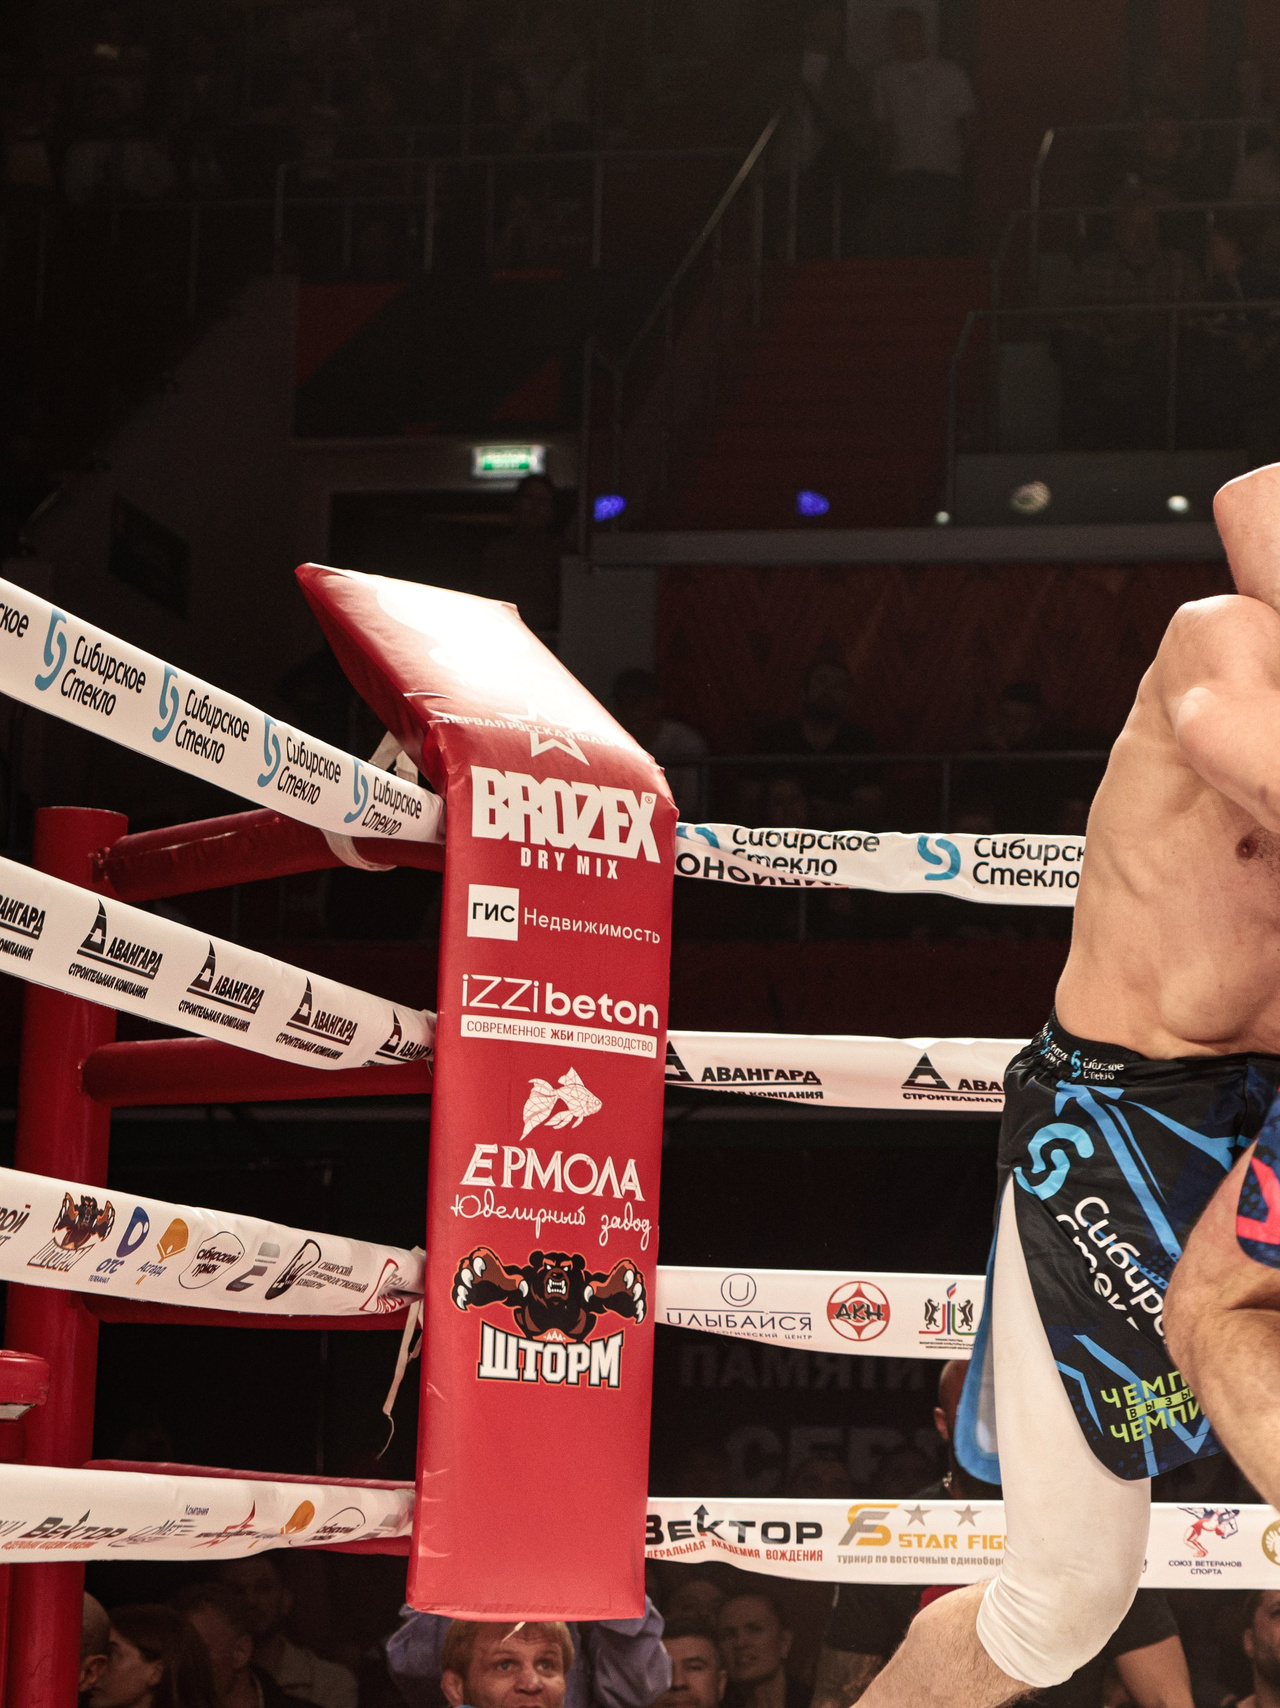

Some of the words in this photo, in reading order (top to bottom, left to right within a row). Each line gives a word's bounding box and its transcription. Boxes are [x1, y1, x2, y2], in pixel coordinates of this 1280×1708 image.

[73, 635, 147, 694] Сибирское
[60, 668, 117, 716] Стекло
[184, 688, 249, 742] Сибирское
[175, 720, 226, 764] Стекло
[286, 737, 342, 784] Сибирское
[277, 765, 321, 805] Стекло
[373, 775, 423, 819] Сибирское
[361, 804, 402, 836] Стекло
[471, 765, 661, 863] BROZEX
[732, 828, 880, 853] Сибирское
[520, 847, 565, 872] DRY
[577, 855, 618, 879] MIX
[972, 861, 1080, 888] Стекло
[472, 902, 516, 923] ГИС
[524, 907, 661, 944] Недвижимость
[106, 936, 163, 980] АВАНГАРД
[68, 963, 115, 990] СТРОИТЕЛЬНАЯ
[115, 976, 148, 999] КОМПАНИЯ
[212, 975, 265, 1014] АВАНГАРД
[178, 1000, 219, 1024] СТРОИТЕЛЬНАЯ
[219, 1011, 250, 1032] КОМПАНИЯ
[312, 1010, 358, 1045] АВАНГАРД
[276, 1032, 313, 1053] СТРОИТЕЛЬНАЯ
[312, 1040, 343, 1060] КОМПАНИЯ
[466, 1020, 547, 1039] СОВРЕМЕННОЕ
[550, 1028, 574, 1042] ЖБИ
[577, 1031, 654, 1053] ПРОИЗВОДСТВО
[701, 1067, 822, 1085] АВАНГАРД
[460, 1143, 646, 1202] ЕРМОЛА
[450, 1188, 587, 1239] Ювелирный
[478, 1321, 625, 1388] ШТОРМ
[711, 1539, 761, 1559] АКАДЕМИЯ
[765, 1550, 823, 1562] ВОЖДЕНИЯ
[837, 1555, 873, 1564] турнир
[875, 1555, 887, 1563] по
[890, 1555, 948, 1565] восточным
[899, 1534, 958, 1549] STAR
[1195, 1560, 1243, 1568] ВЕТЕРАНОВ
